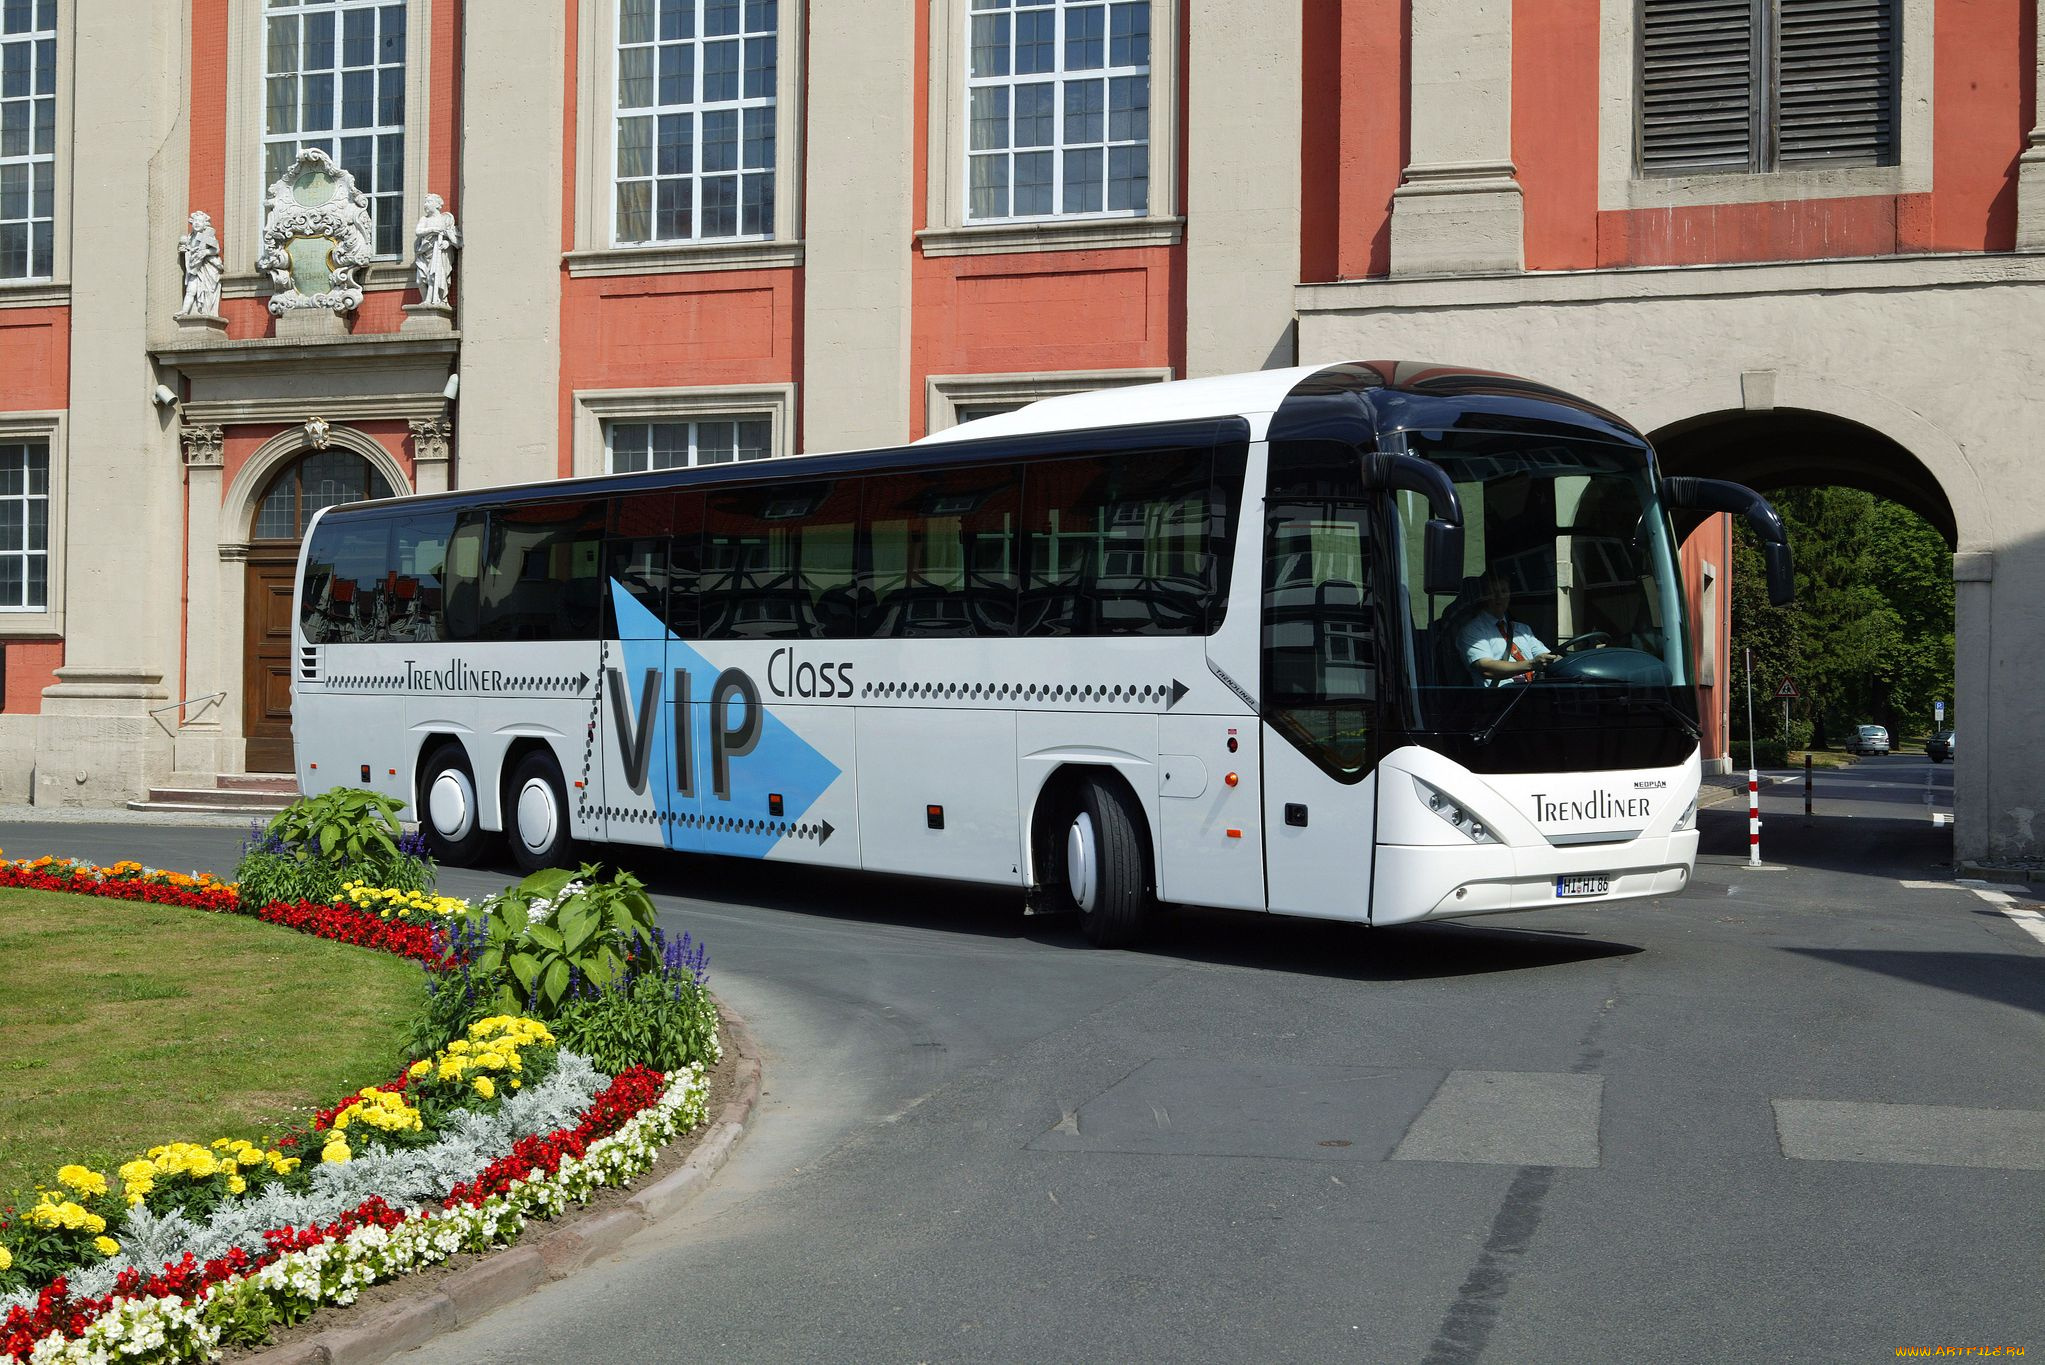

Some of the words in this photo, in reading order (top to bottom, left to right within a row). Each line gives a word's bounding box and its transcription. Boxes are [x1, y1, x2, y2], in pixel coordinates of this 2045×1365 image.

[606, 666, 764, 801] VIP
[767, 646, 854, 699] Class
[1633, 780, 1667, 790] NEOPLAN
[1597, 876, 1609, 892] 86
